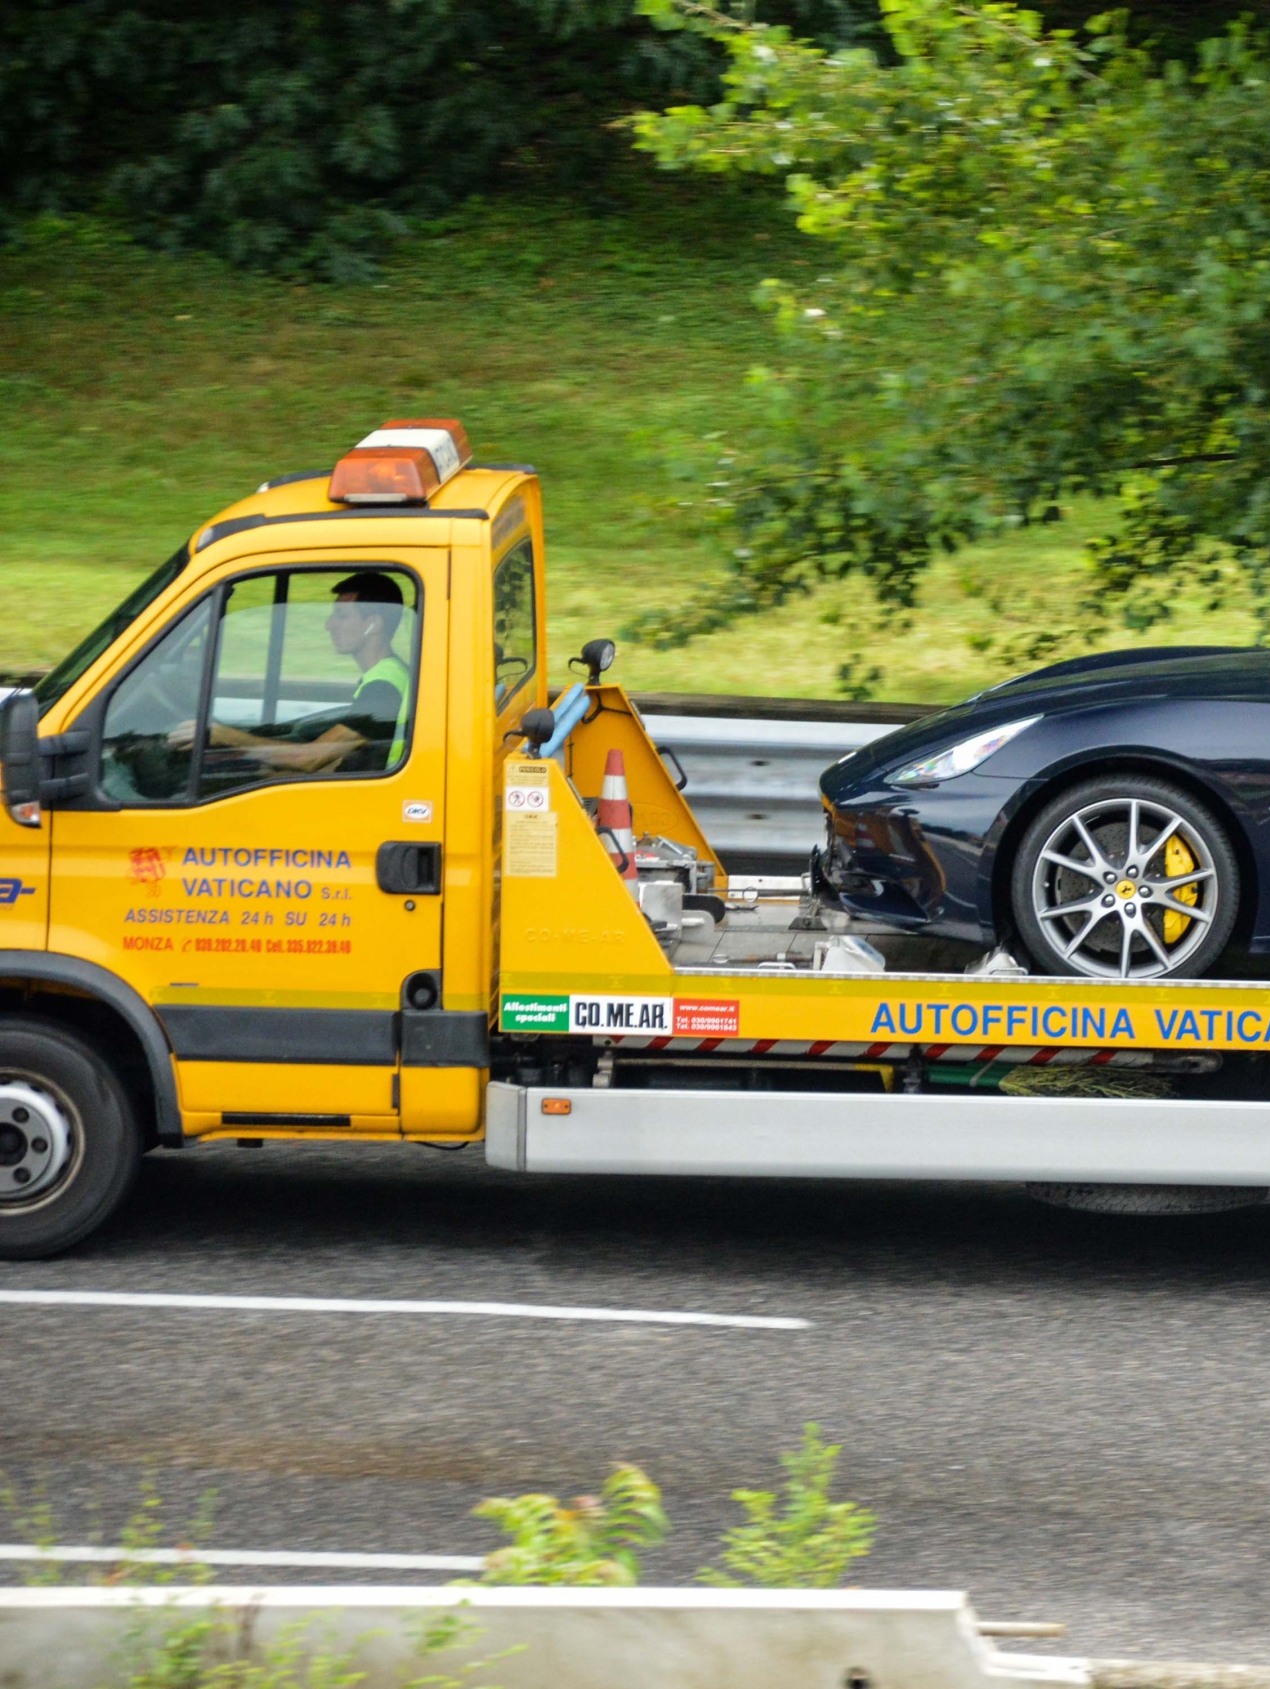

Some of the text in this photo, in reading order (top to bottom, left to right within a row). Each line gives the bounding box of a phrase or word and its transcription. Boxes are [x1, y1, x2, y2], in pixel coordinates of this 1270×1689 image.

[182, 848, 352, 869] AUTOFFICINA
[182, 878, 313, 899] VATICANO
[124, 908, 230, 925] ASSISTENZA
[285, 911, 308, 926] SU
[122, 936, 173, 951] MONZA
[503, 1001, 568, 1012] Allestimenti
[679, 1004, 735, 1013] www.comear.it
[515, 1012, 556, 1024] speciali
[871, 1003, 1135, 1039] AUTOFFICINA
